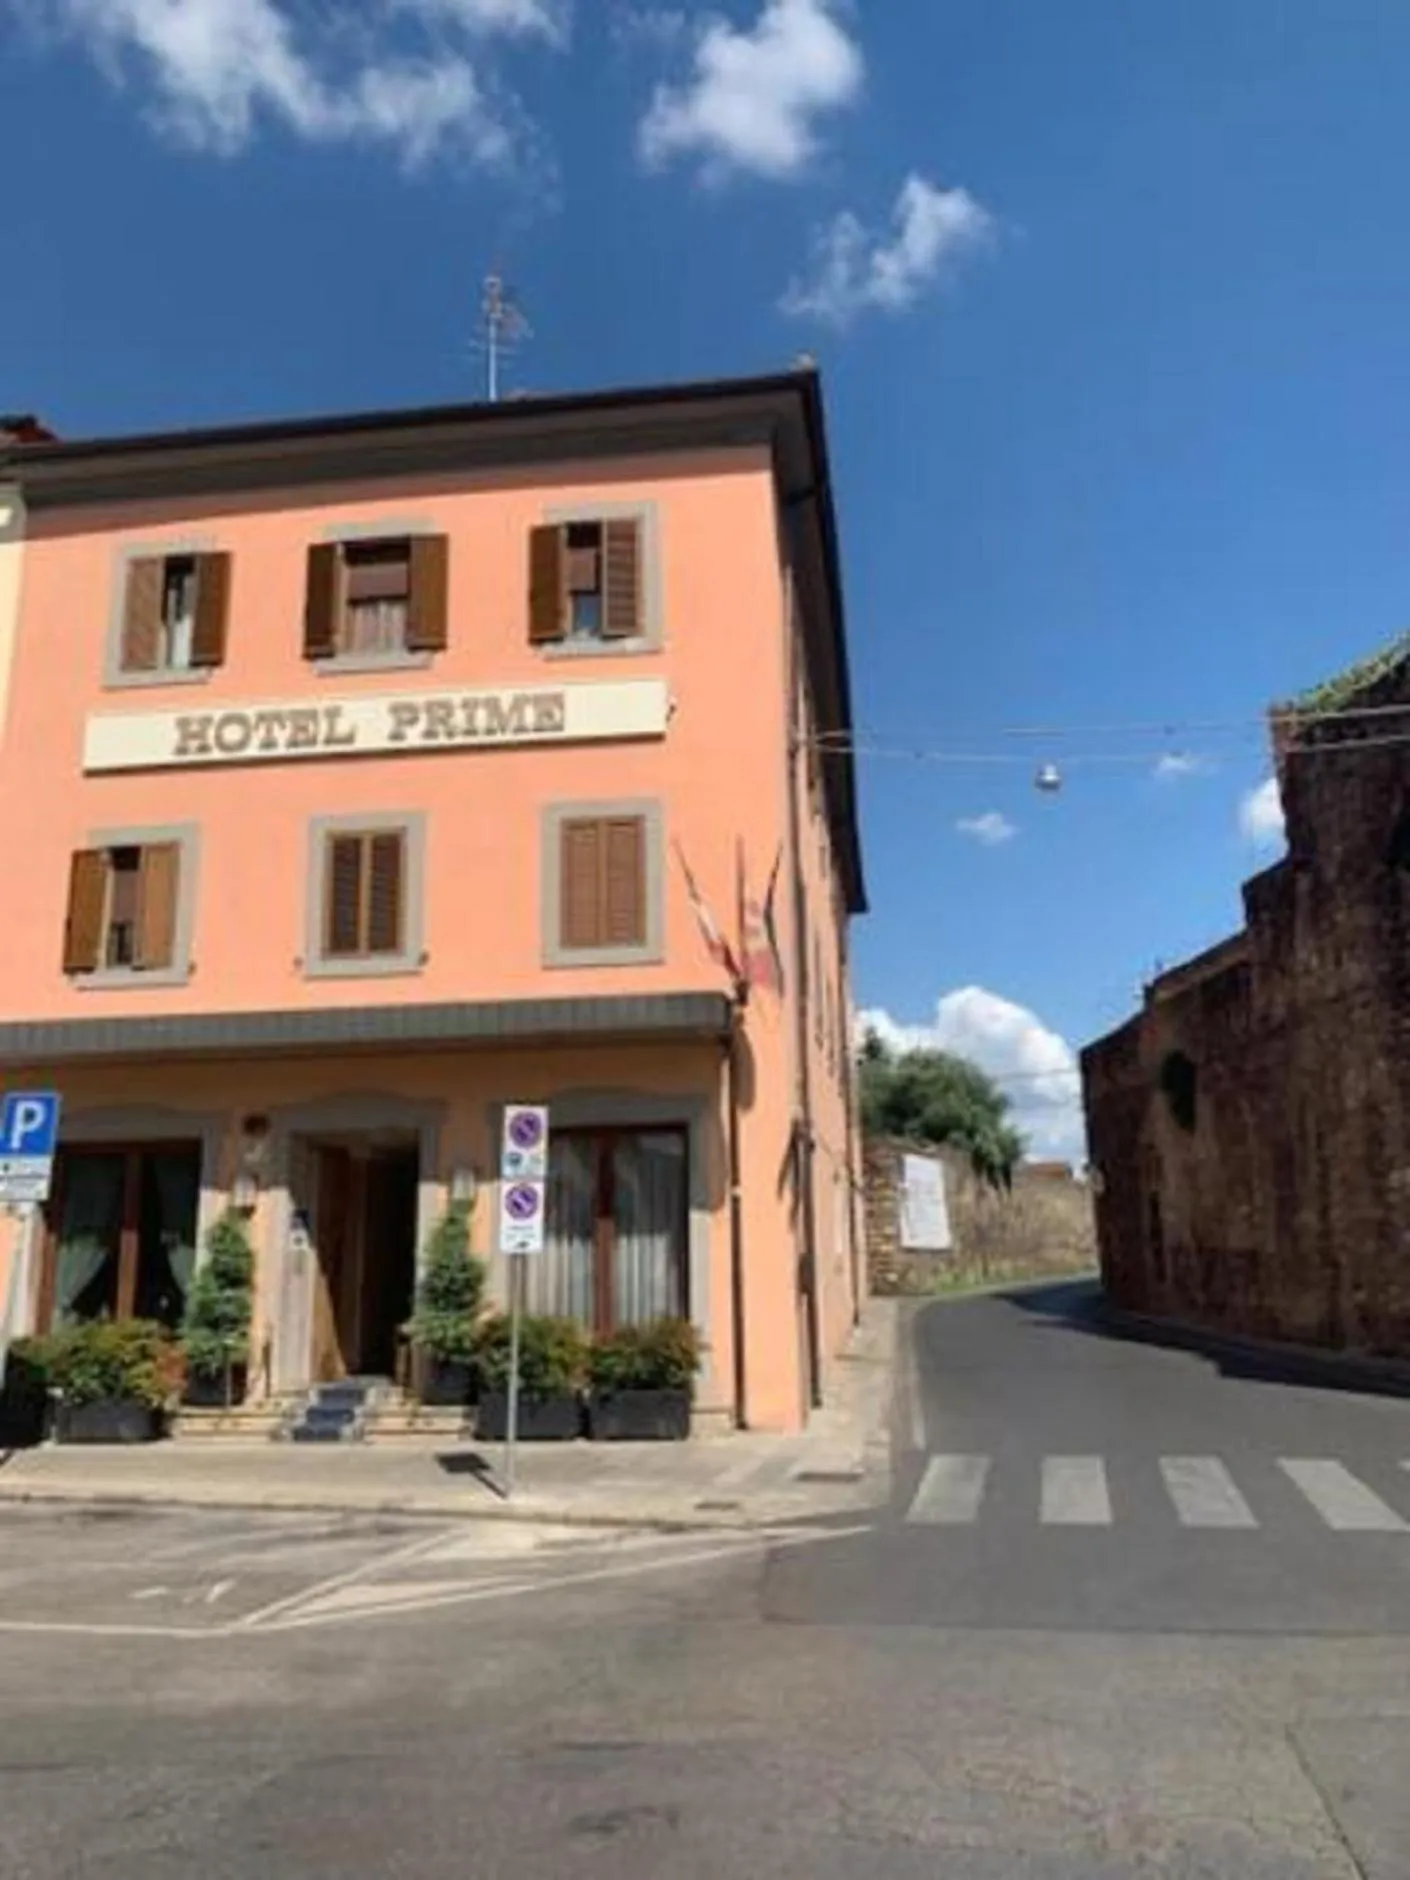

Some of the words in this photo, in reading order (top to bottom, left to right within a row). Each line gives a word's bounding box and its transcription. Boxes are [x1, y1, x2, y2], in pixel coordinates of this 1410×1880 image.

[174, 706, 356, 756] HOTEL
[387, 692, 565, 742] PRIME
[11, 1100, 45, 1148] P
